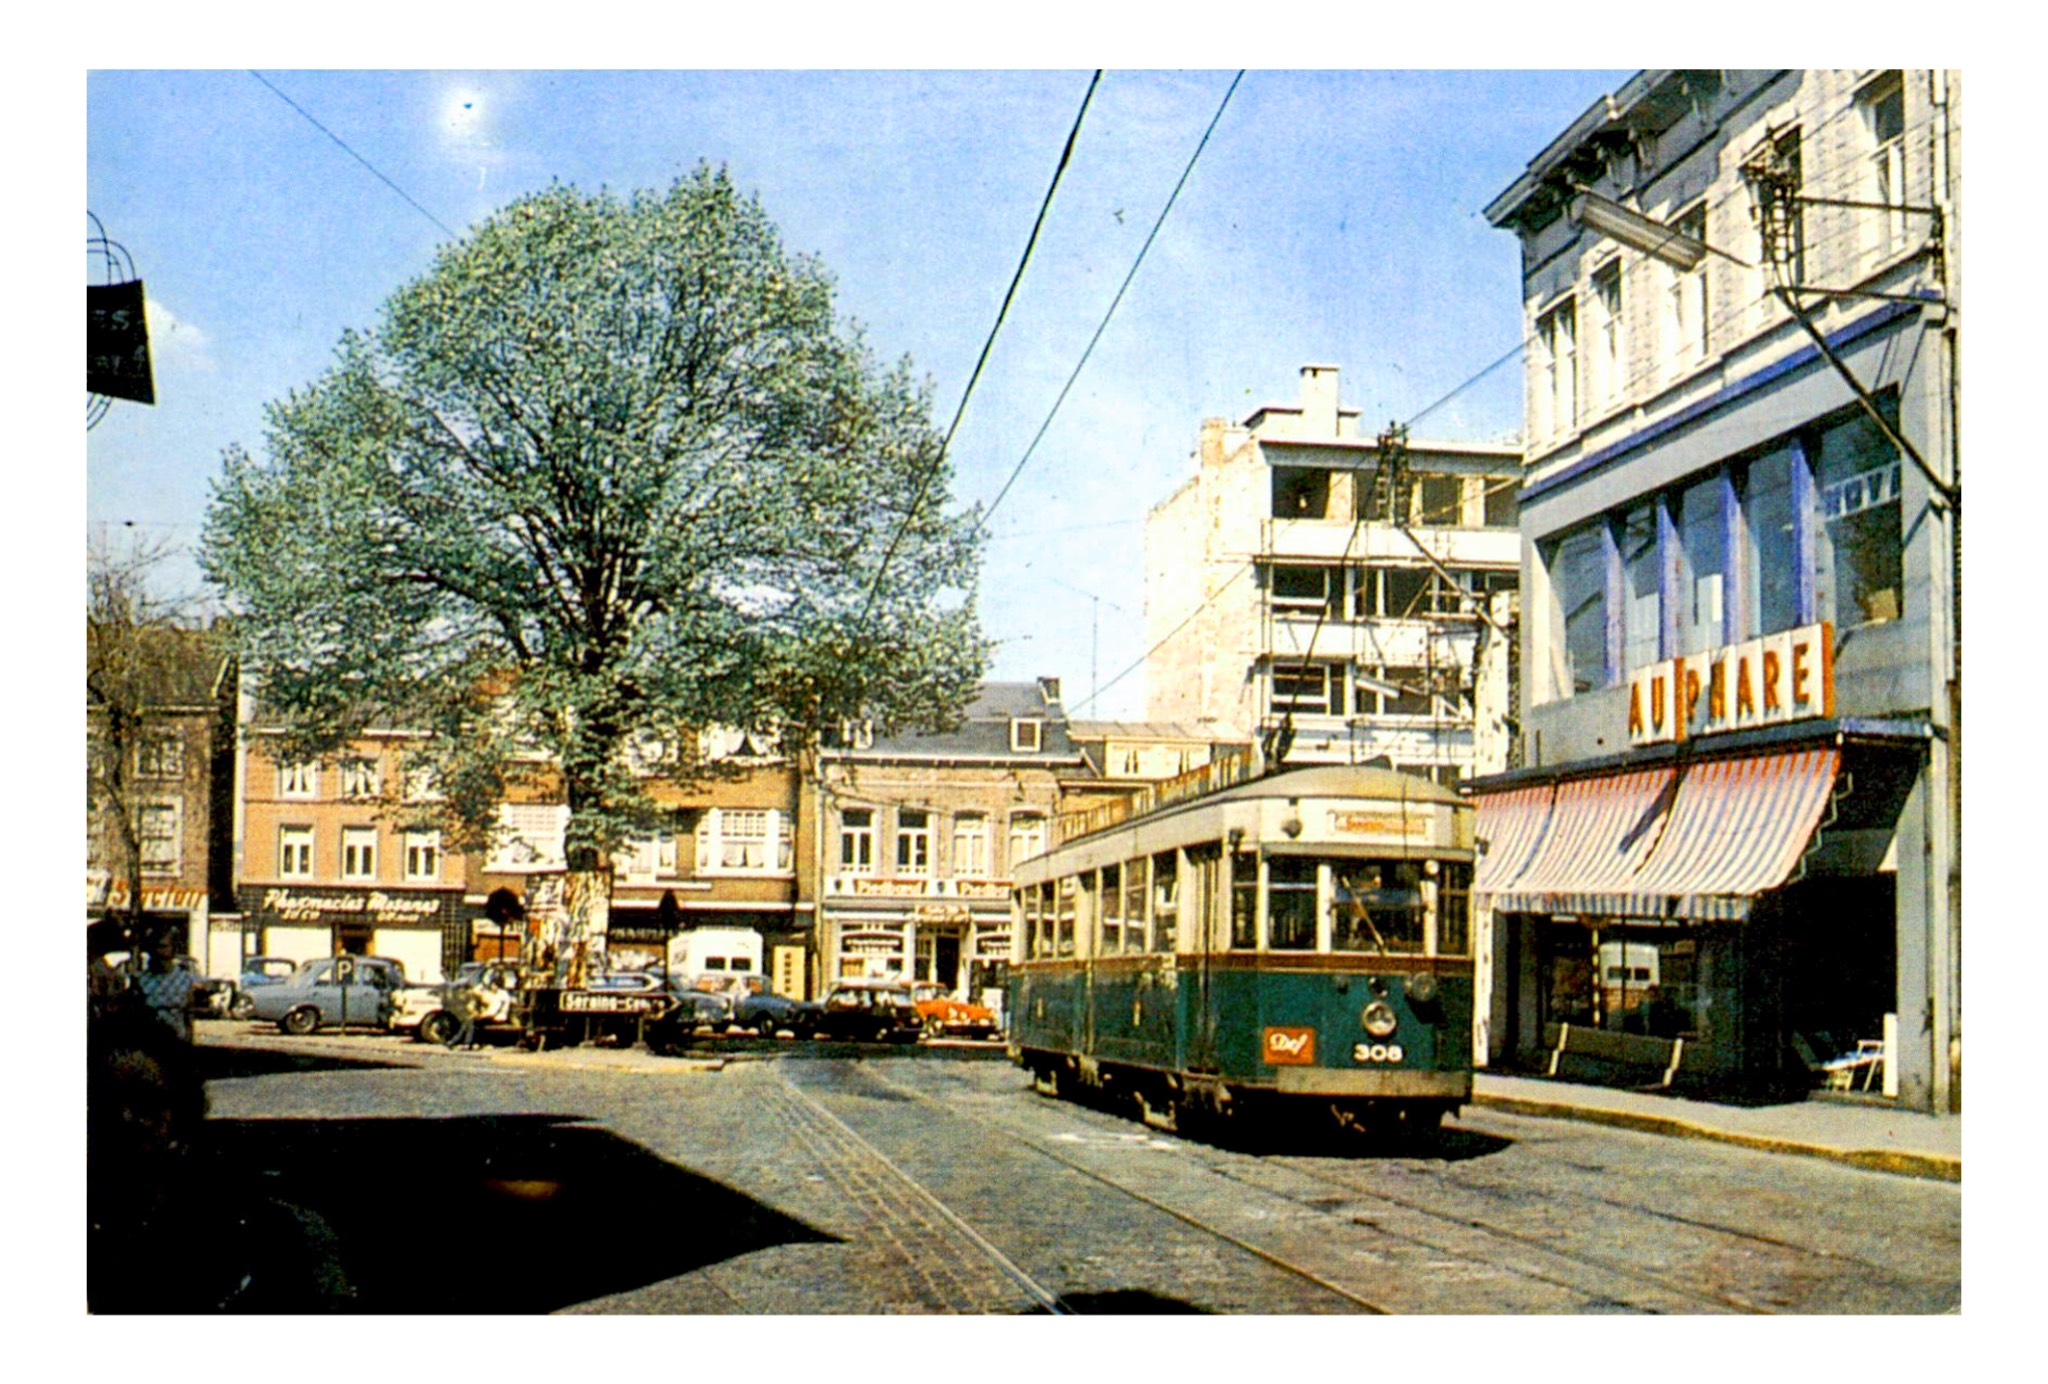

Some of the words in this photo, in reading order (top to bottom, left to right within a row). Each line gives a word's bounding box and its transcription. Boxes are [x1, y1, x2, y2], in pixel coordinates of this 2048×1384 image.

[1629, 675, 1665, 735] AU
[1686, 643, 1810, 724] PHARE
[338, 961, 352, 981] P
[1353, 1043, 1403, 1062] 308
